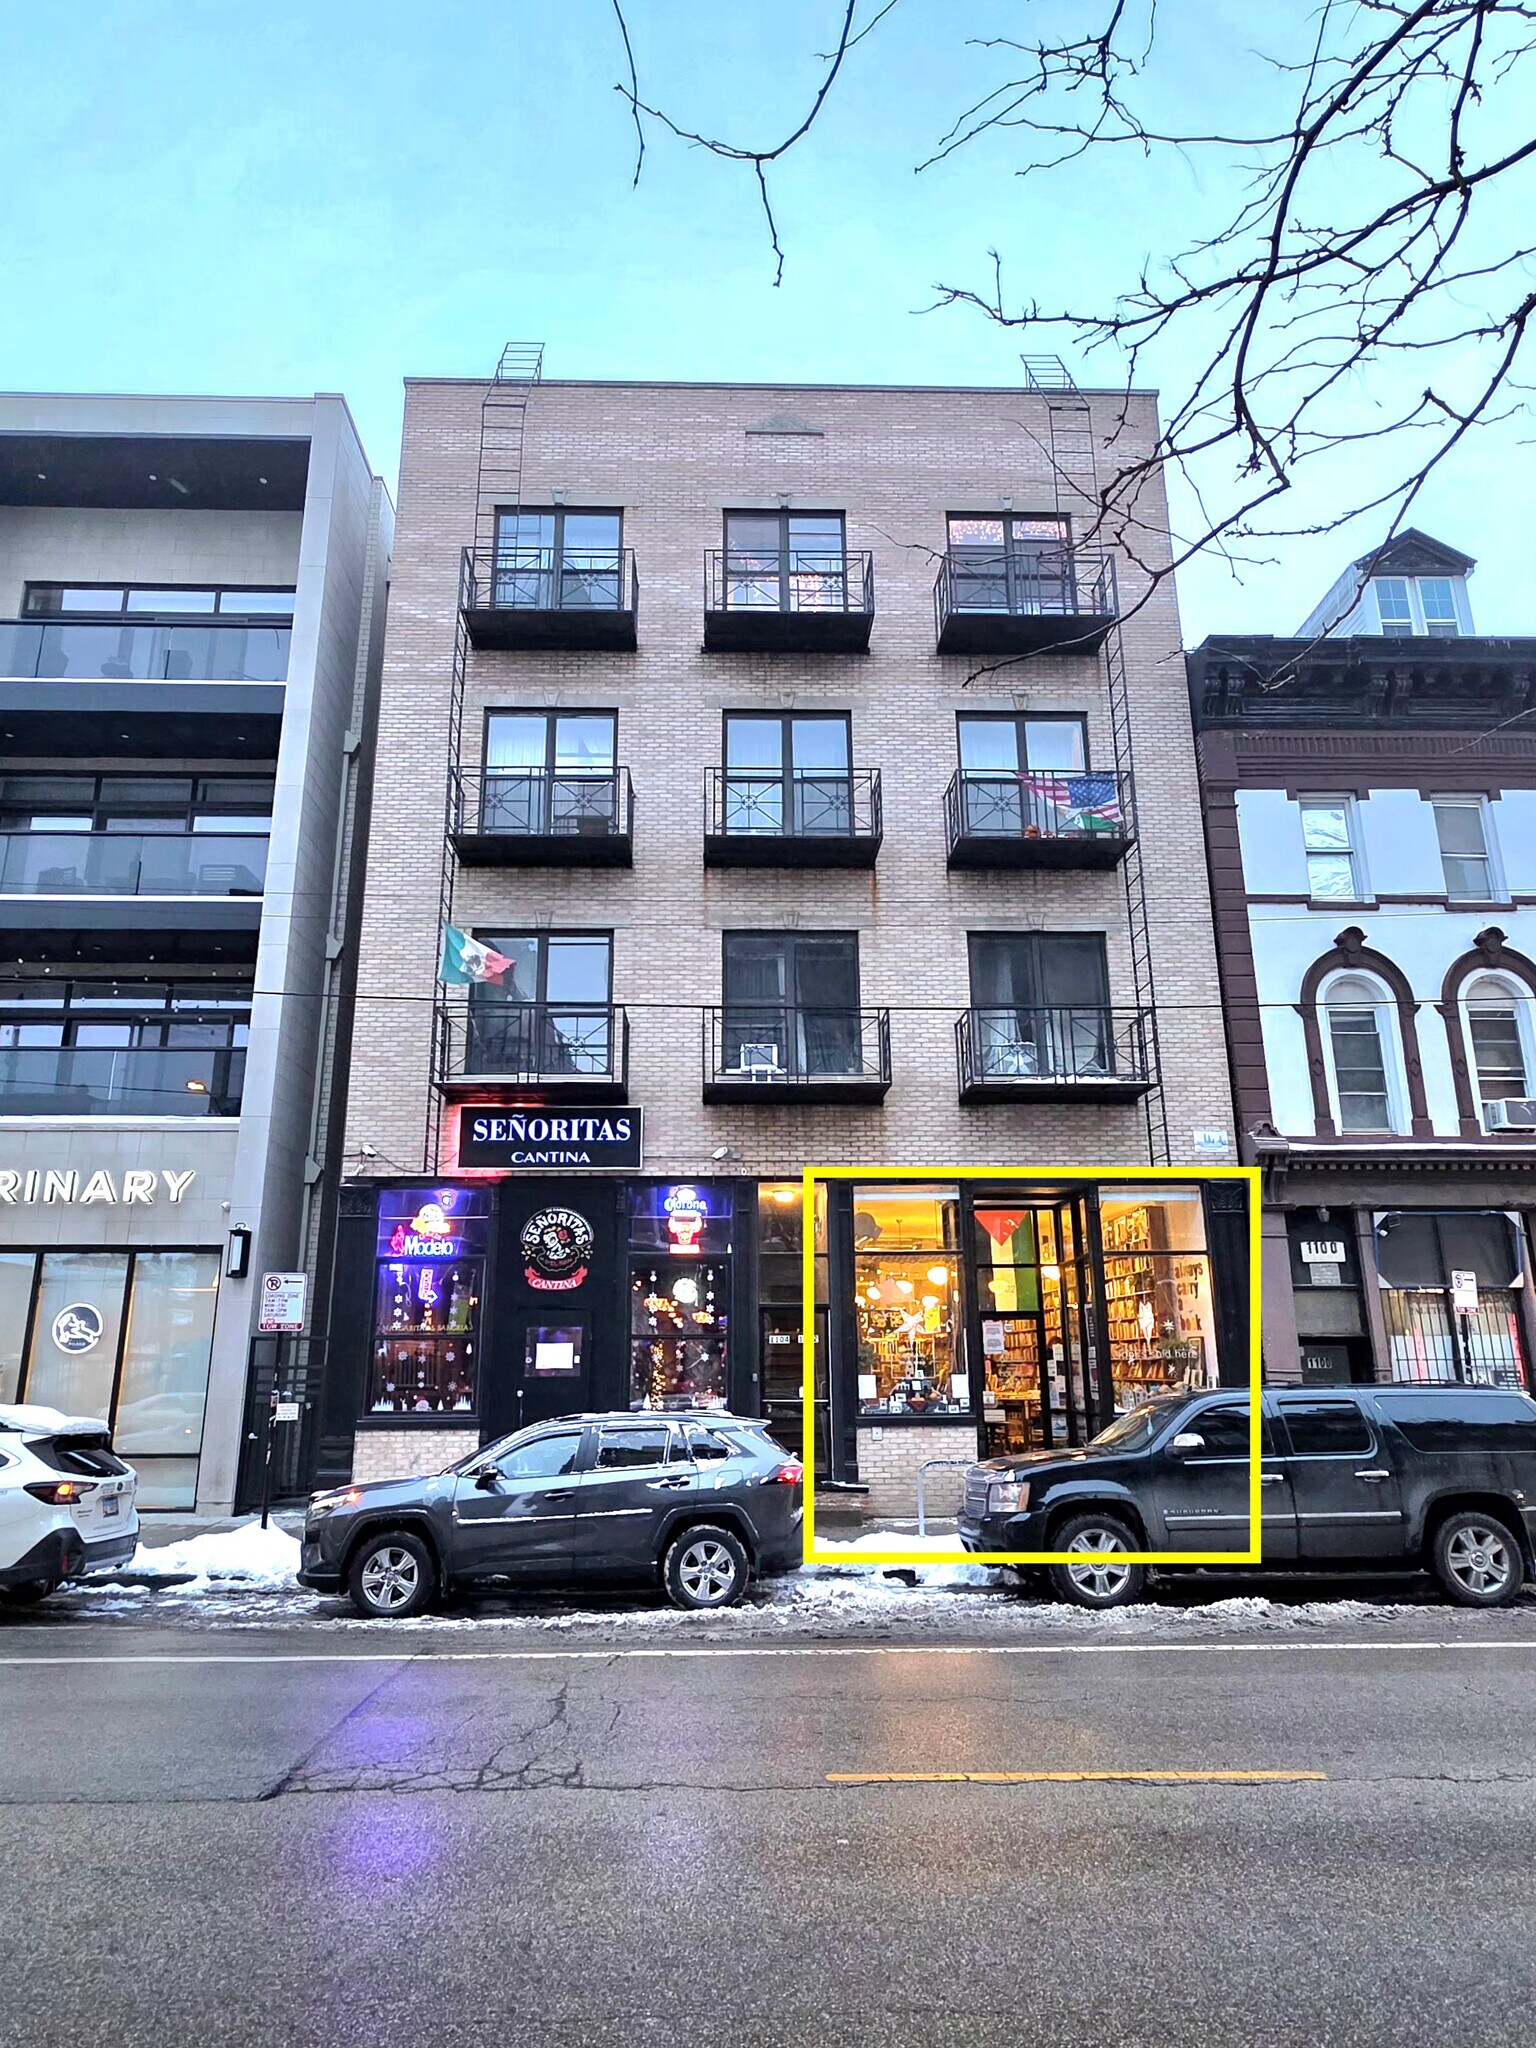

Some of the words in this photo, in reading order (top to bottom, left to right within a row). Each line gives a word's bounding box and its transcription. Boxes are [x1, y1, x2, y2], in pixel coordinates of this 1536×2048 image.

[473, 1114, 631, 1142] SEÑORITAS
[511, 1151, 590, 1163] CANTINA
[0, 1169, 196, 1205] RINARY
[664, 1197, 707, 1212] Corona
[525, 1212, 589, 1244] SEÑORITAS
[404, 1235, 454, 1256] Modelo
[1306, 1241, 1338, 1254] 1100
[532, 1278, 577, 1290] CANTINA
[1174, 1348, 1198, 1359] here
[1308, 1357, 1332, 1369] 1100
